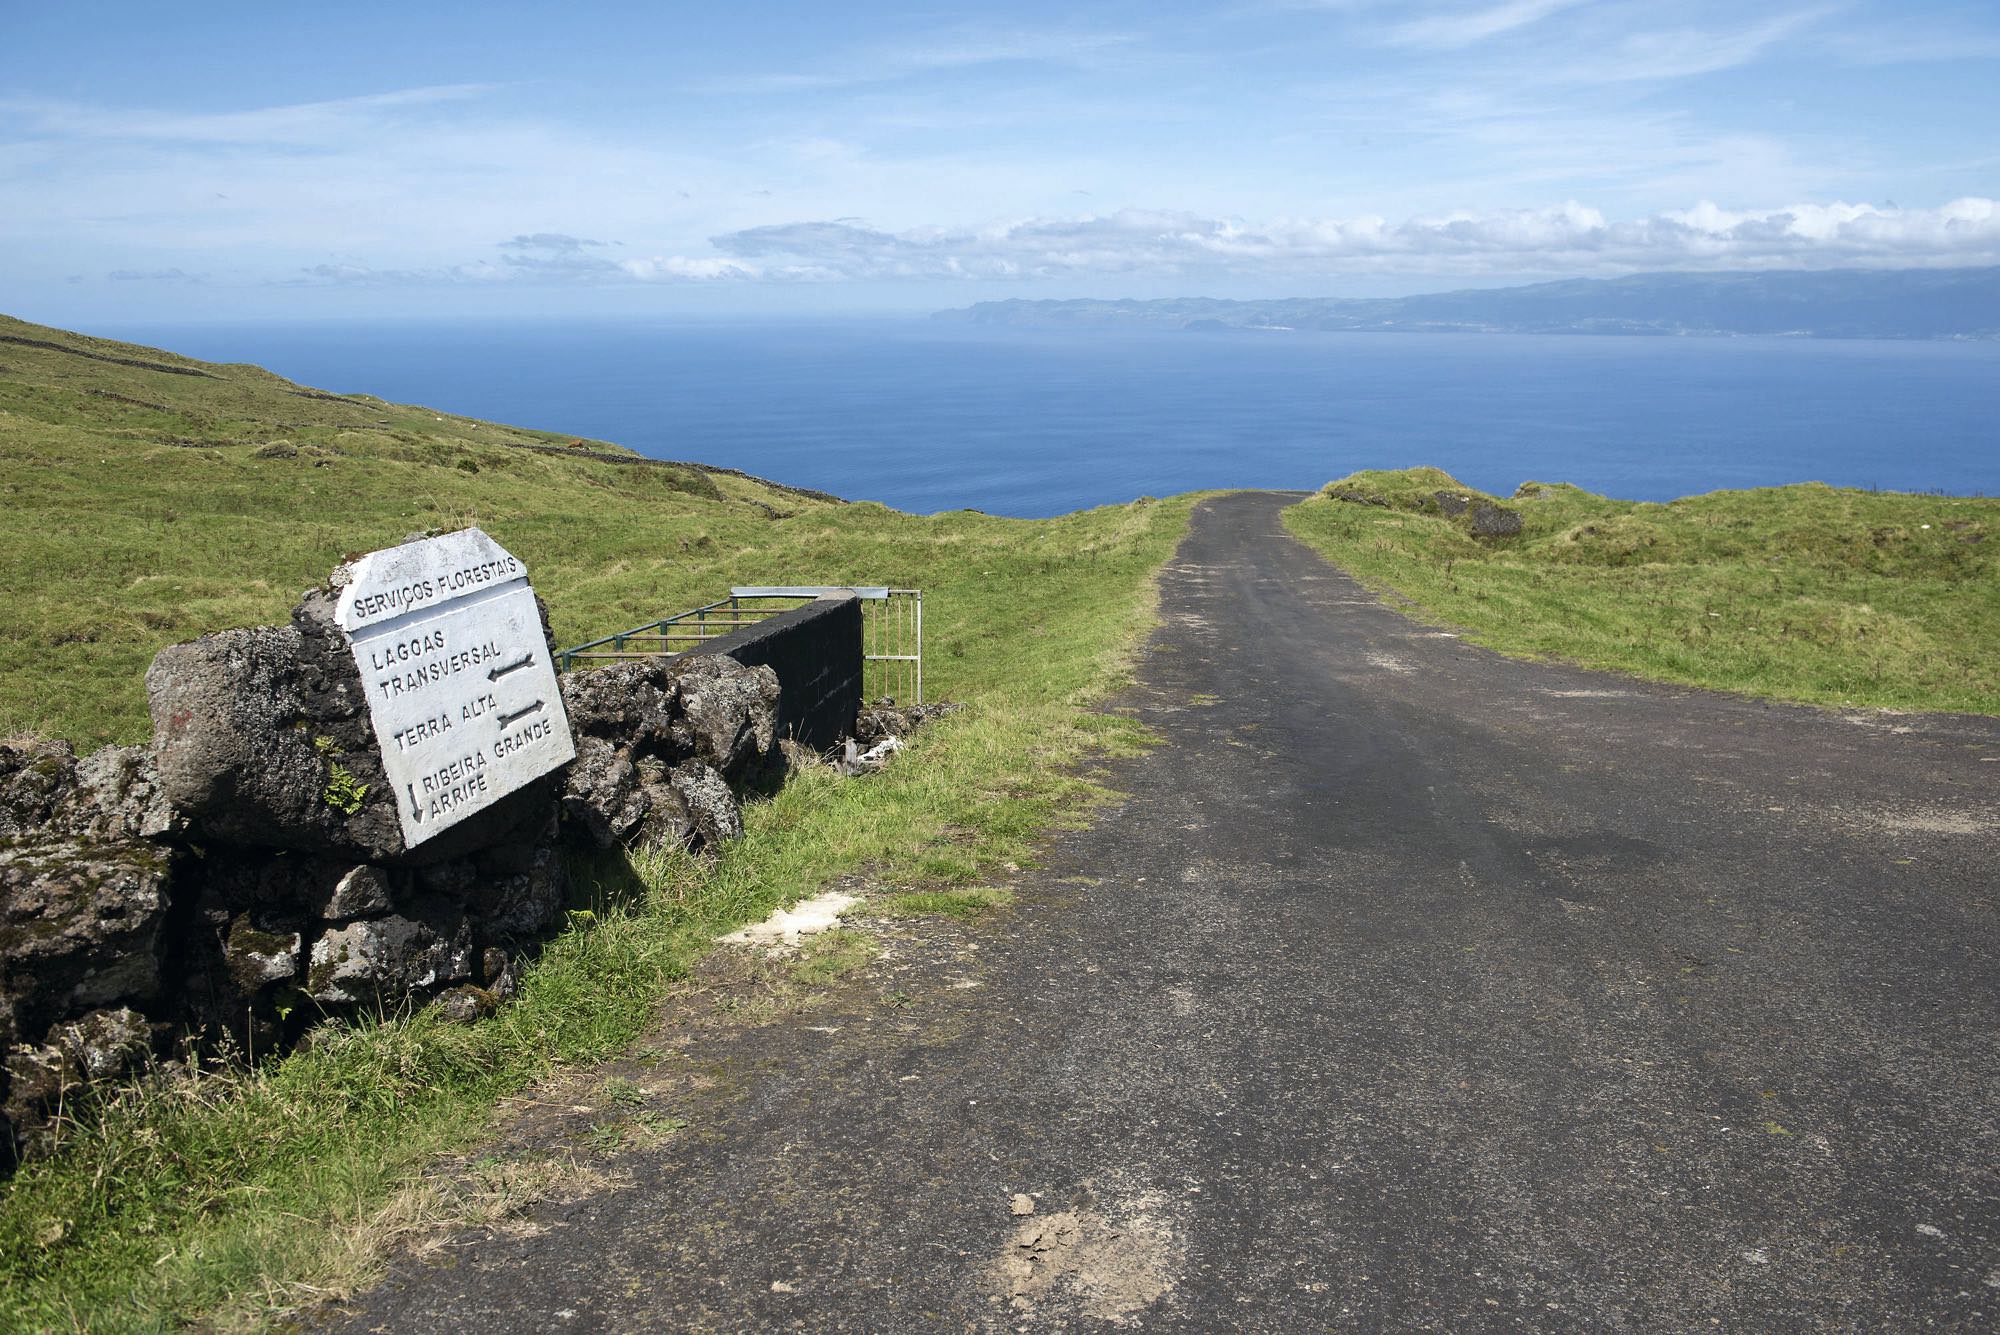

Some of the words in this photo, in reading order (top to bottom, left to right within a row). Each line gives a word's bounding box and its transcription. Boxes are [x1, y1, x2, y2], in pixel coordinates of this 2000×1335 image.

[354, 581, 433, 618] SERVIÇOS
[437, 556, 517, 593] FLORESTAIS
[372, 631, 444, 670] LAGOAS
[379, 641, 501, 699] TRANSVERSAL
[394, 714, 452, 751] TERRA
[462, 694, 497, 721] ALTA
[423, 752, 487, 794] RIBEIRA
[494, 719, 552, 758] GRANDE
[431, 774, 488, 819] ARRIFE
